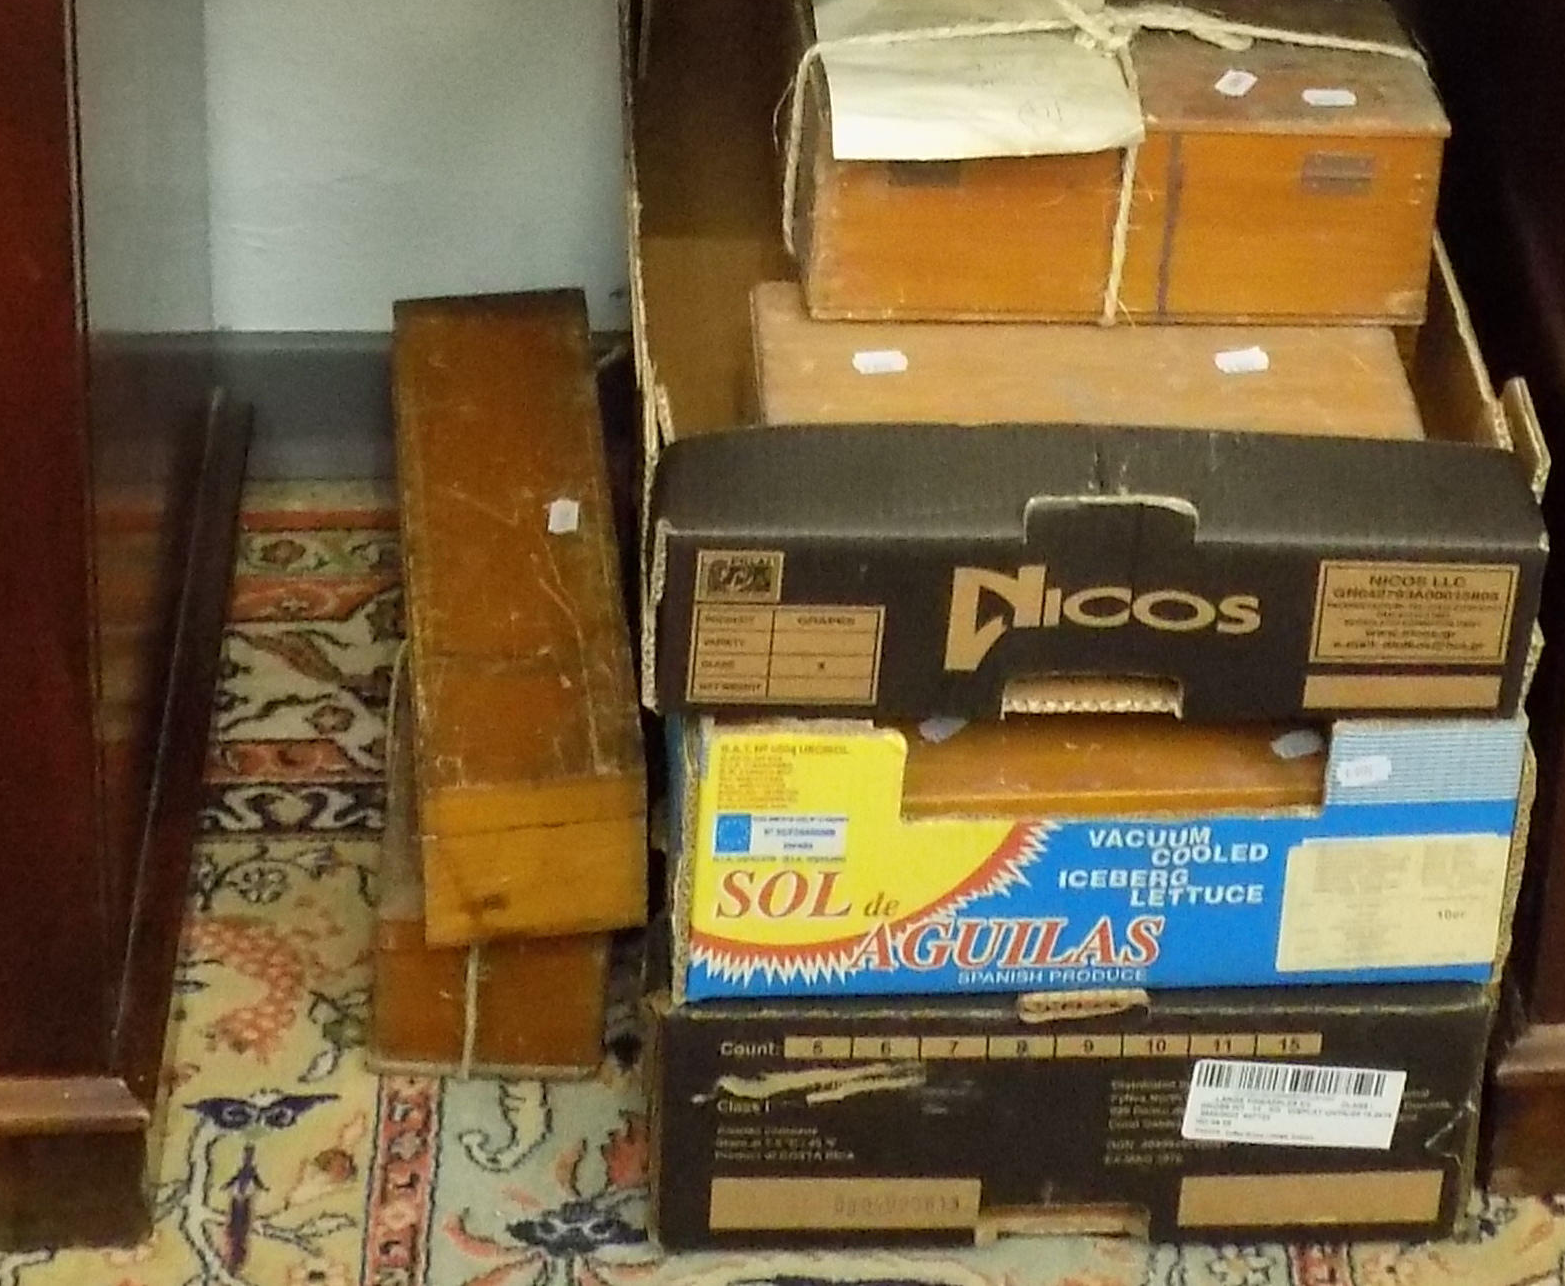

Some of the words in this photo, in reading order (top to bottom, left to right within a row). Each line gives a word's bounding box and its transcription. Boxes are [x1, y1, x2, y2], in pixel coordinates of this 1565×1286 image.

[1088, 826, 1212, 849] VACUUM
[1150, 842, 1270, 868] COOLED
[1057, 867, 1189, 890] ICEBERG
[715, 869, 853, 920] SOL
[863, 892, 901, 919] de
[1129, 883, 1266, 908] LETTUCE
[849, 914, 1166, 973] AGUILAS
[957, 968, 1044, 986] SPANISH
[1047, 966, 1150, 985] PRODUCE
[948, 1040, 960, 1054] 7
[1082, 1039, 1095, 1054] 9
[1147, 1038, 1168, 1054] 10
[1212, 1038, 1233, 1053] 11
